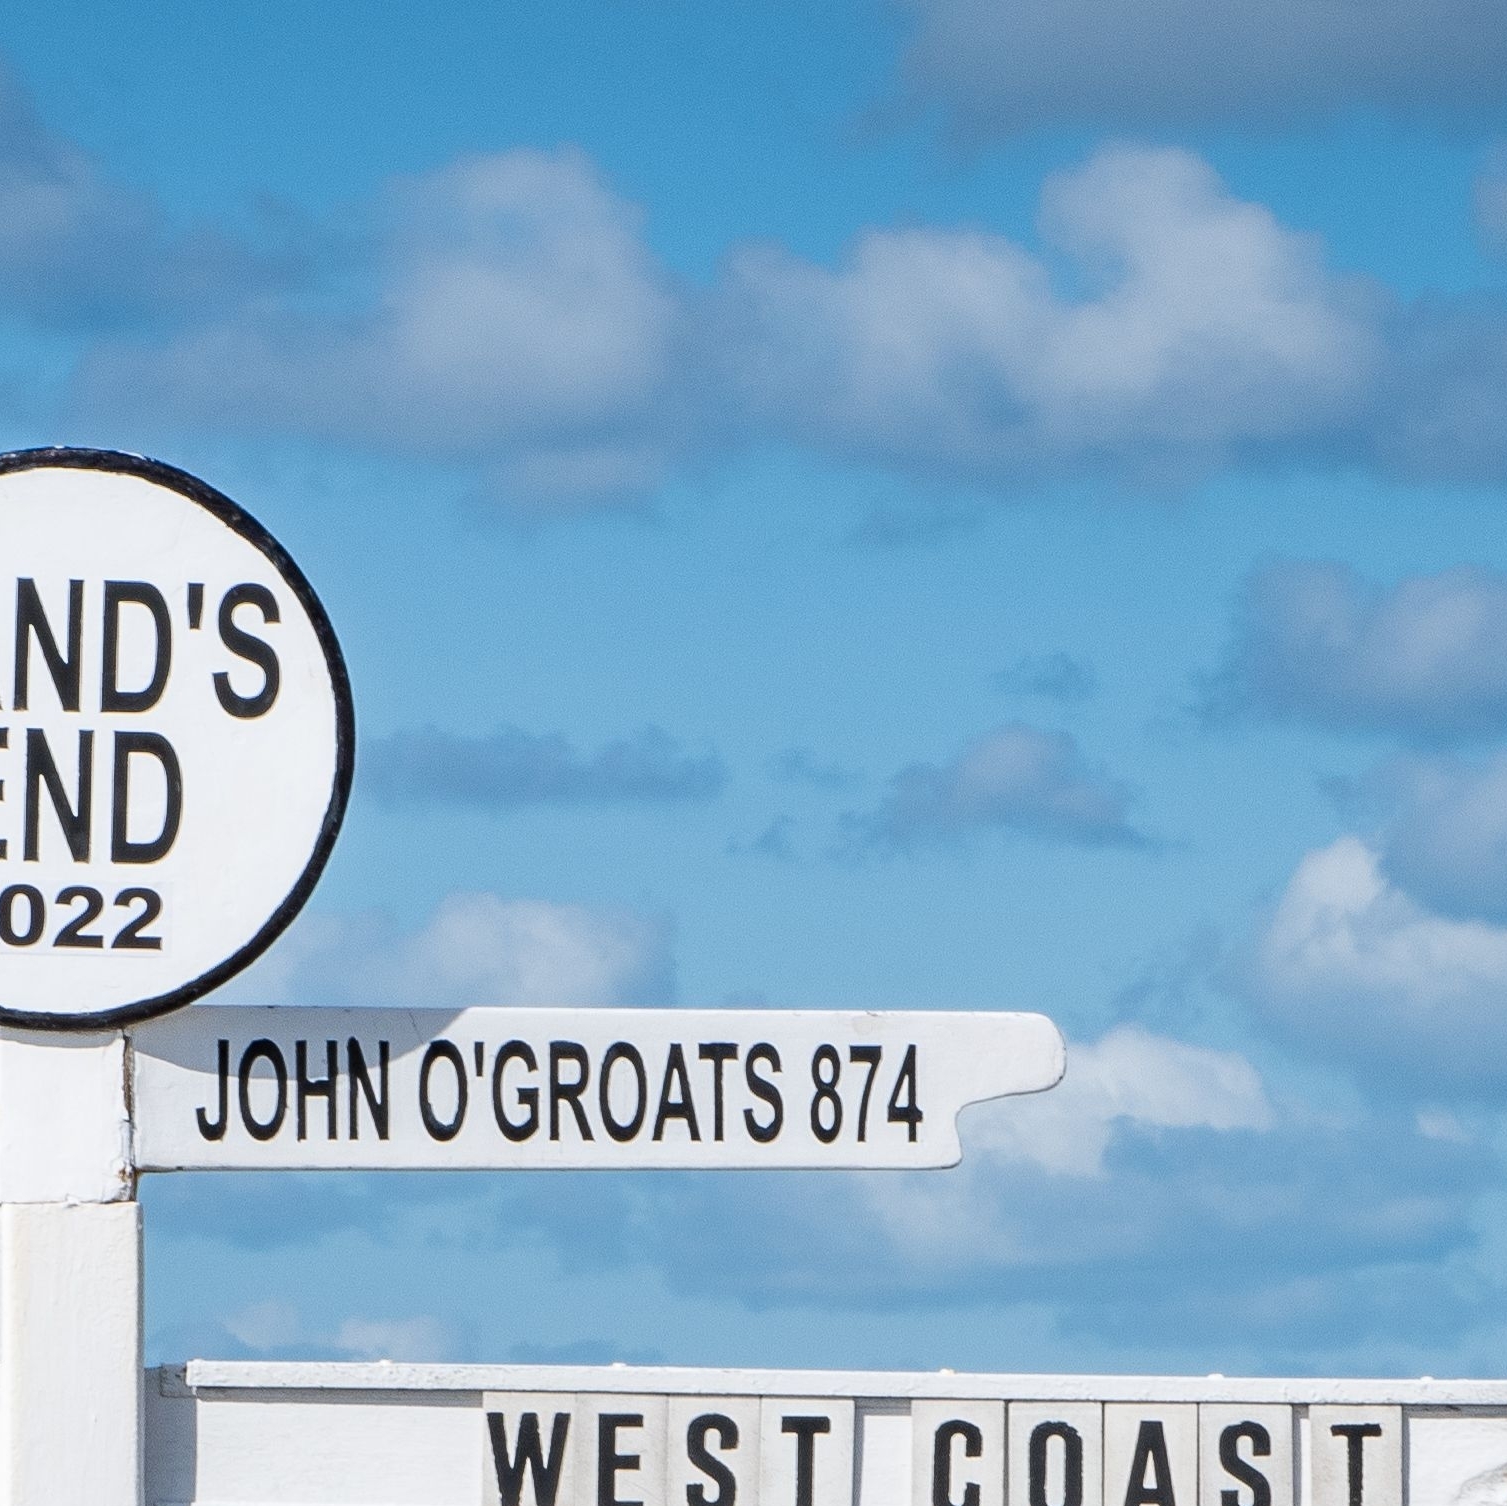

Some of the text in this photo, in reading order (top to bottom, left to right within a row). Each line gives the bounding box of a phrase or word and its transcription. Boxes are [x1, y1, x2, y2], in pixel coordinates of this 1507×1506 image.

[197, 1037, 922, 1143] JOHN O'GROATS 874
